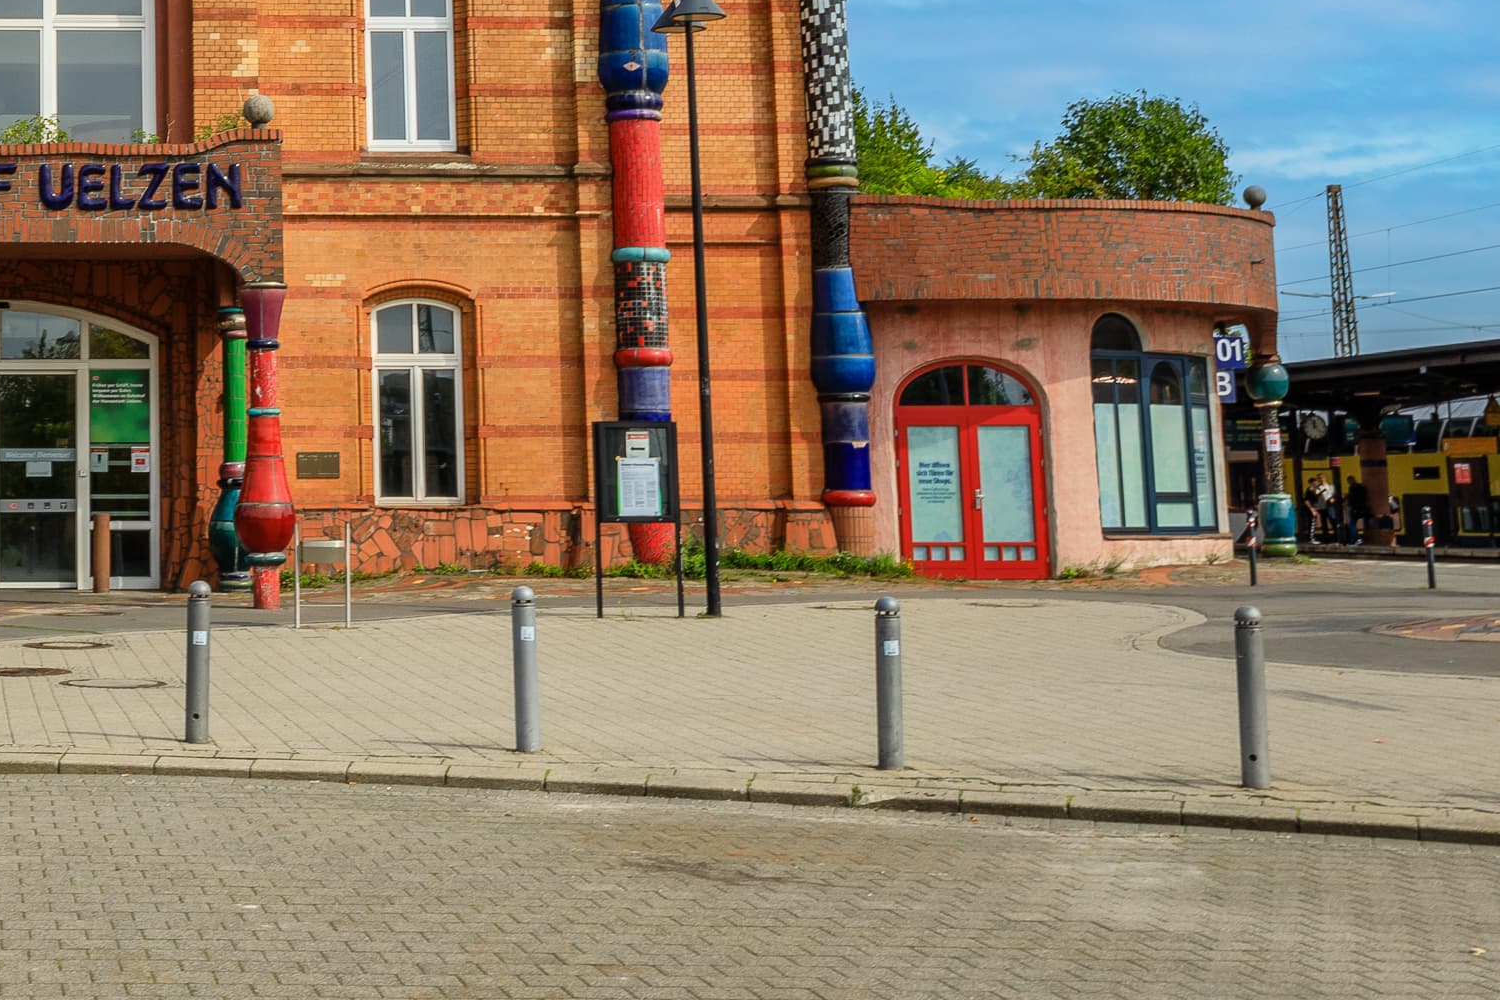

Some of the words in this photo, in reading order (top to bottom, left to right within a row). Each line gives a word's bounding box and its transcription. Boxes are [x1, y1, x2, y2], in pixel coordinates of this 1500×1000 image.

[38, 162, 243, 211] UELZEN
[1216, 338, 1243, 362] 01
[1216, 371, 1232, 397] B
